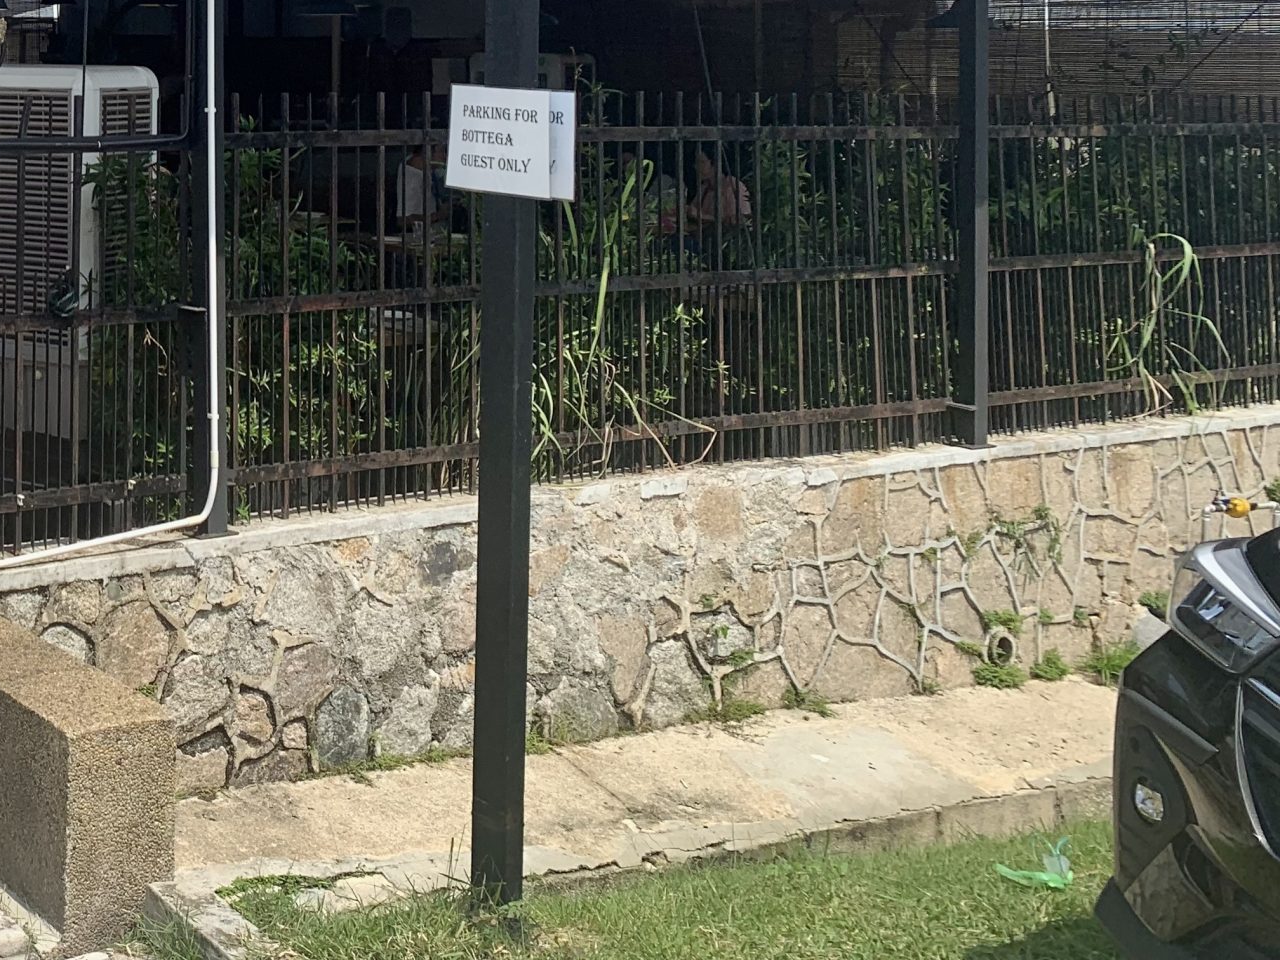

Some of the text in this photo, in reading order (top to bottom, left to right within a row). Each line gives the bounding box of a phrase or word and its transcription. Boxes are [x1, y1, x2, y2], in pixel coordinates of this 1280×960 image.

[463, 104, 538, 124] PARKING FOR
[462, 129, 514, 147] BOTTEGA
[460, 153, 495, 170] GUEST
[497, 157, 532, 174] ONLY
